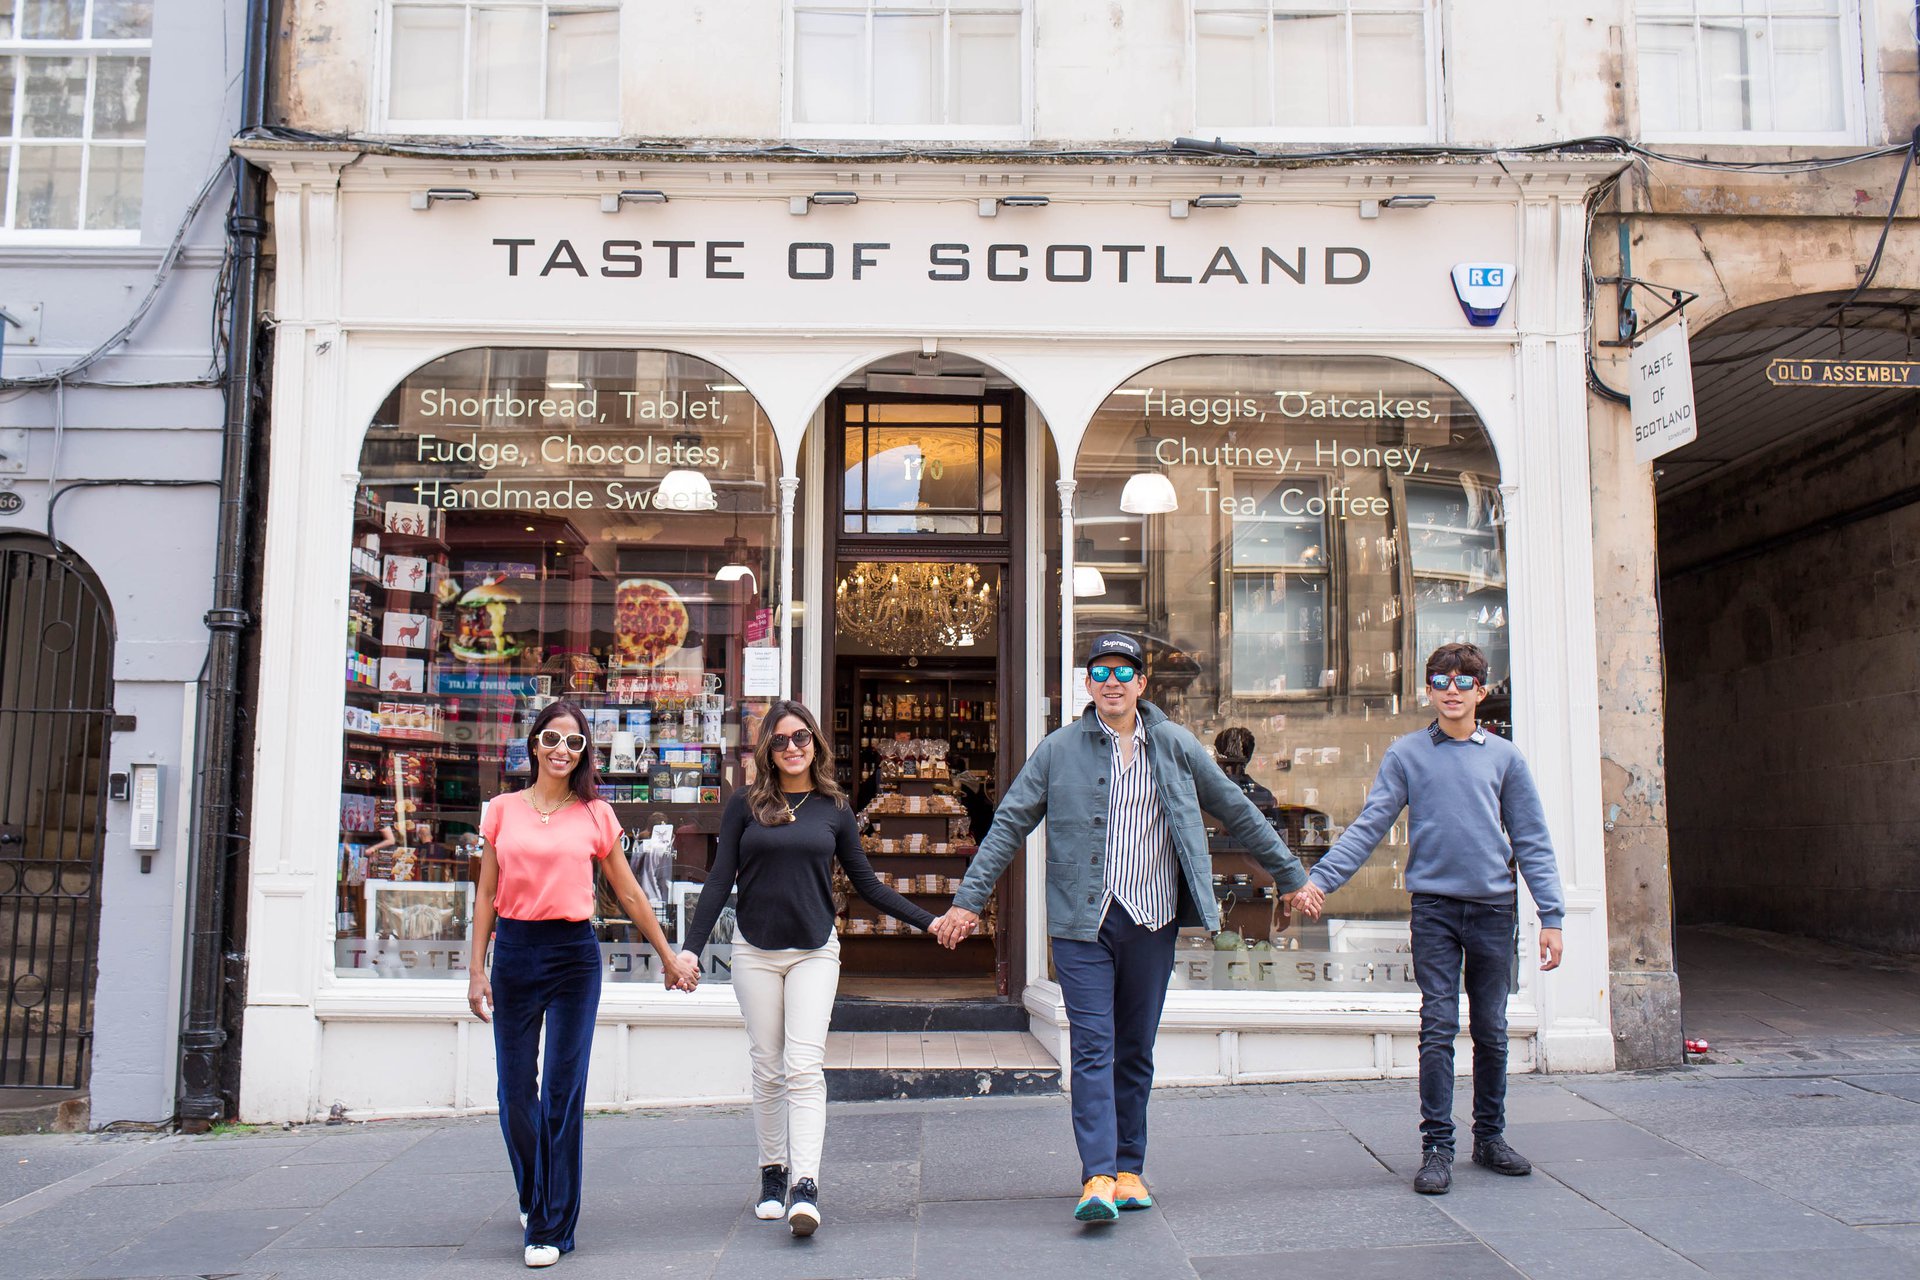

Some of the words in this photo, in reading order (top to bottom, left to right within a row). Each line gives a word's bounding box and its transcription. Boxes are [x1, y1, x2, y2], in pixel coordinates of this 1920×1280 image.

[492, 238, 745, 279] TASTE
[787, 242, 891, 280] OF
[927, 243, 1371, 284] SCOTLAND
[1471, 269, 1501, 286] RG
[1640, 352, 1674, 381] TASTE
[1778, 364, 1813, 381] OLD
[1822, 365, 1911, 383] ASSEMBLY
[419, 387, 608, 424] Shortbread,
[618, 390, 730, 425] Tablet,
[1144, 390, 1267, 425] Haggis,
[1278, 389, 1441, 424] Oatcakes,
[1652, 386, 1666, 405] OF
[1635, 404, 1692, 442] SCOTLAND
[416, 433, 529, 471] Fudge,
[540, 434, 729, 471] Chocolates,
[1155, 437, 1302, 475] Chutney,
[1314, 439, 1430, 476] Honey,
[903, 458, 944, 480] 170
[416, 480, 594, 510] Handmade
[605, 482, 719, 511] Sweets
[1197, 487, 1267, 519] Tea,
[1280, 486, 1389, 516] Coffee
[346, 950, 467, 970] TSTE
[1296, 962, 1417, 982] SCOTL
